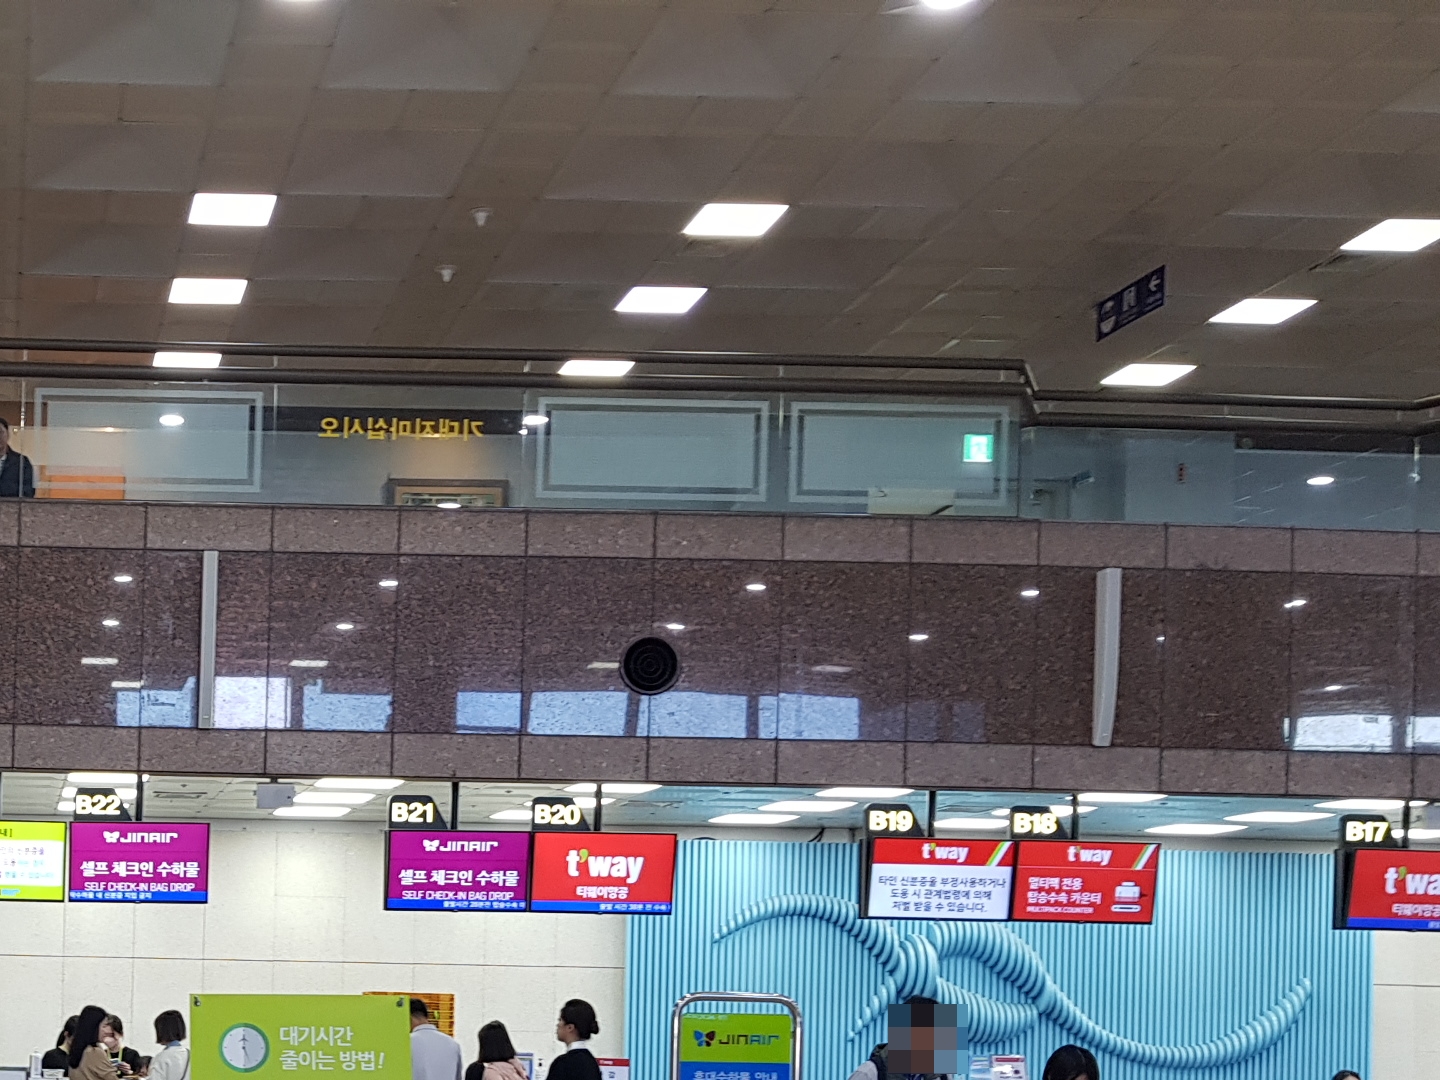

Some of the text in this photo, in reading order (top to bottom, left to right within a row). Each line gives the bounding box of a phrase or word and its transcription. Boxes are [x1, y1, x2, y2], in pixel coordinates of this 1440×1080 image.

[75, 794, 121, 815] B22
[391, 802, 434, 823] B21
[534, 803, 581, 825] B20
[868, 810, 914, 832] B19
[1013, 812, 1058, 835] B18
[1345, 821, 1389, 843] B17
[921, 842, 970, 863] t'way
[80, 861, 200, 878] 셀프 체크인 수하물
[566, 848, 645, 884] t'way
[84, 881, 196, 892] SELF CHECK-IN BAG DROP
[398, 869, 520, 887] 셀프 체크인 수하물
[878, 875, 897, 886] 타인
[900, 876, 937, 887] 신분증을
[1061, 877, 1084, 890] 전용
[402, 890, 514, 901] SELF CHECK-IN BAG DROP
[576, 885, 629, 899] 티웨이항공
[890, 888, 992, 901] 도용 시 관계법령에 의해
[1026, 891, 1102, 905] 탑승수속 카운터
[892, 901, 910, 912] 처벌
[913, 901, 932, 912] 받을
[934, 902, 944, 912] 수
[279, 1025, 354, 1046] 대기시간
[279, 1050, 385, 1071] 줄이는 방법!
